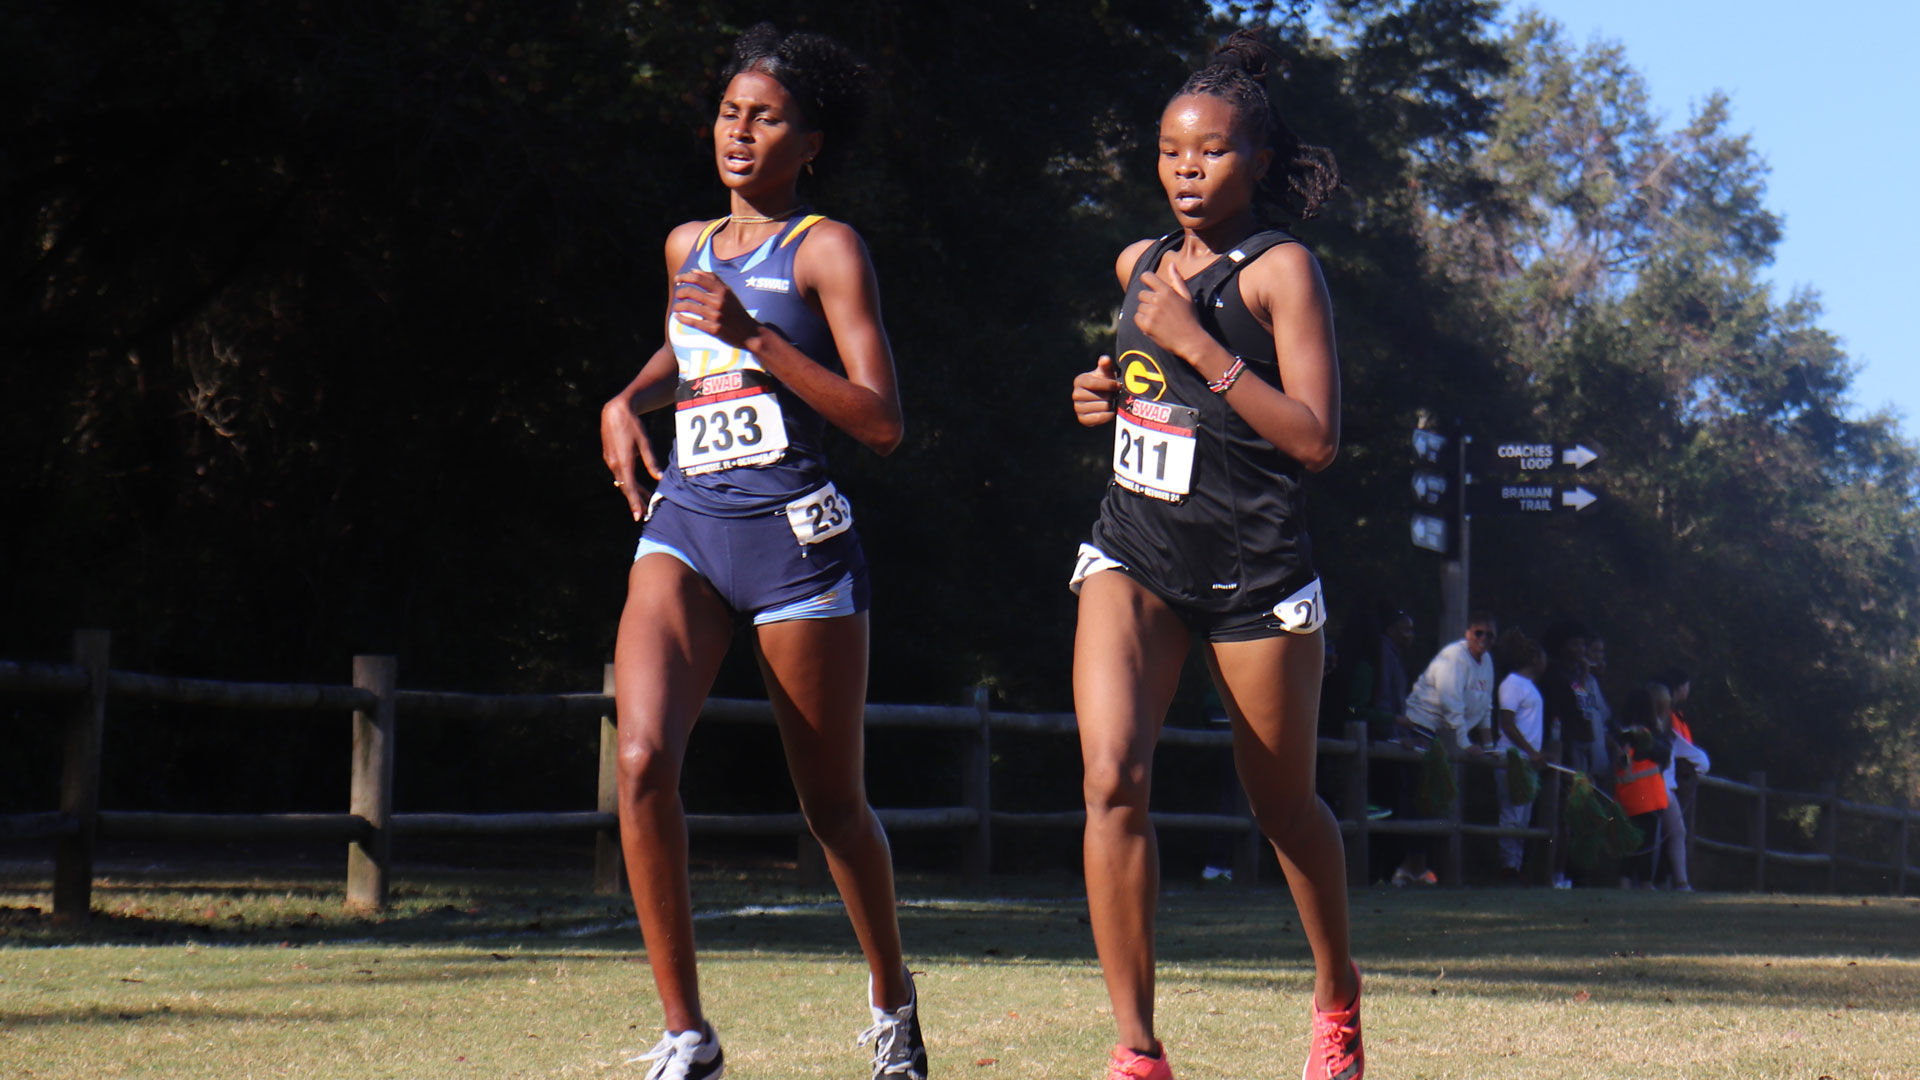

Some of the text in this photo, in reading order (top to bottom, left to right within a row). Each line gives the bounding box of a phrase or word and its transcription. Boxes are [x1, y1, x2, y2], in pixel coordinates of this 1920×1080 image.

[754, 277, 790, 291] SWAC
[702, 373, 742, 396] SWAC
[1132, 400, 1171, 424] SWAC
[690, 405, 763, 456] 233
[1120, 427, 1169, 481] 211
[1498, 445, 1553, 458] COACHES
[1520, 458, 1553, 470] LOOP
[1501, 487, 1552, 499] BRAMAN
[1520, 499, 1552, 511] TRAIL
